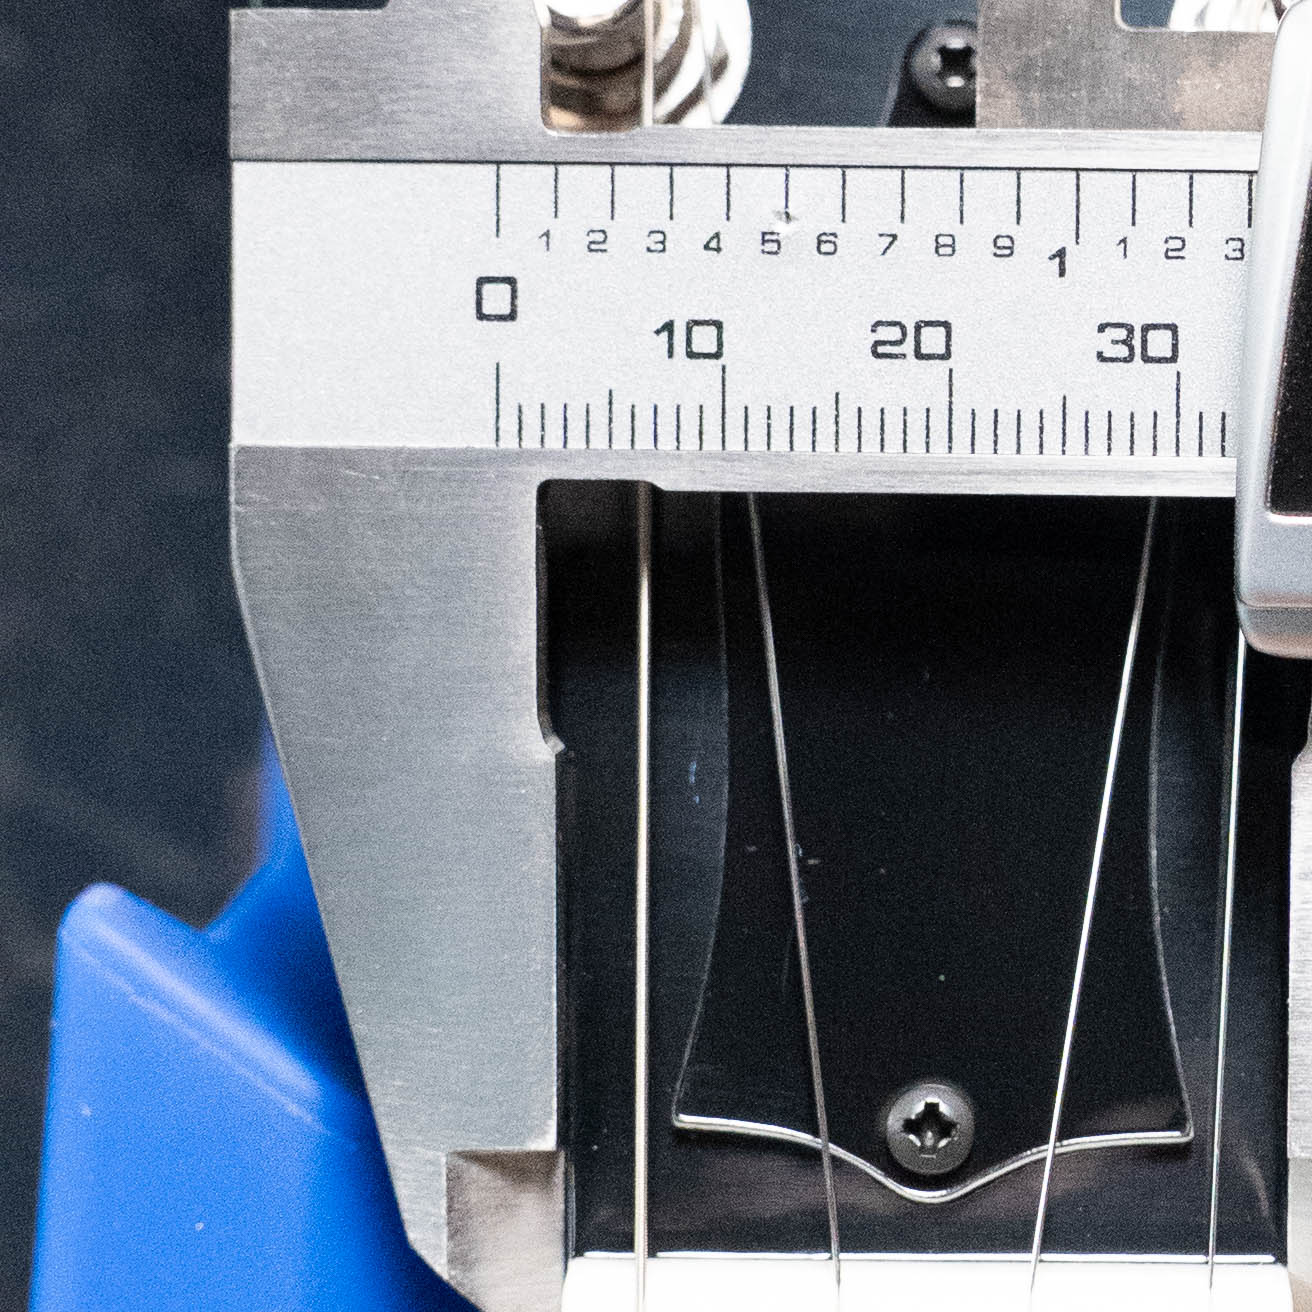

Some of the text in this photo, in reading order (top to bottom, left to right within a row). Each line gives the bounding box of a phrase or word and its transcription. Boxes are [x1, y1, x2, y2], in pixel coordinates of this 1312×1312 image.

[538, 229, 1246, 278] 1 2 3 4 5 6 7 8 9 1 1 2 3
[475, 275, 518, 323] 0
[653, 318, 1180, 365] 10 20 30
